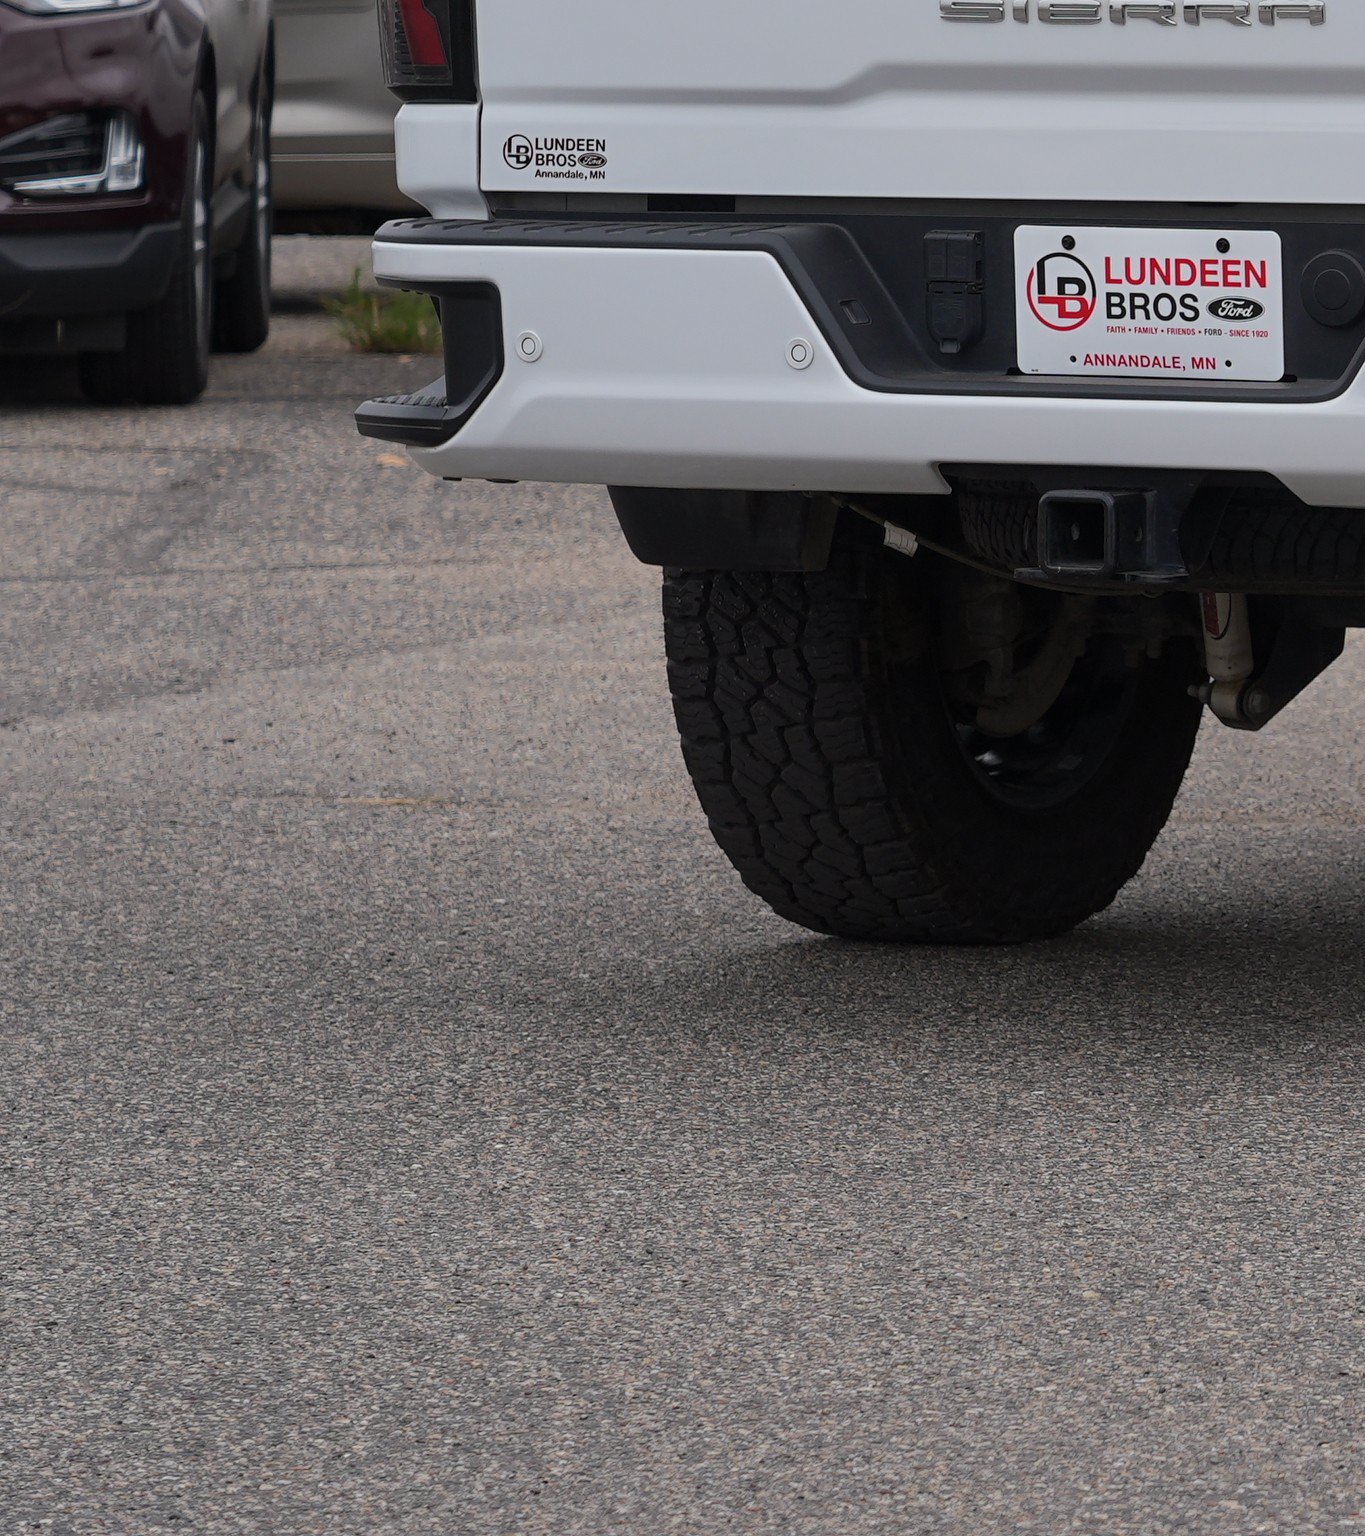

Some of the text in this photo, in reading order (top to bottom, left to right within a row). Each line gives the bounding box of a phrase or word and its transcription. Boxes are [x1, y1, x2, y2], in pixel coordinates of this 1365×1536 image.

[535, 137, 606, 152] LUNDEEN
[535, 153, 577, 167] BROS
[535, 169, 606, 181] Annandale, MN
[1104, 256, 1267, 289] LUNDEEN
[1105, 292, 1200, 322] BROS
[1217, 299, 1255, 319] Ford
[1106, 325, 1269, 338] FAITH FAMILY FRIENDS FORD SINCE 1920
[1083, 353, 1217, 372] ANNANDALE, MN
